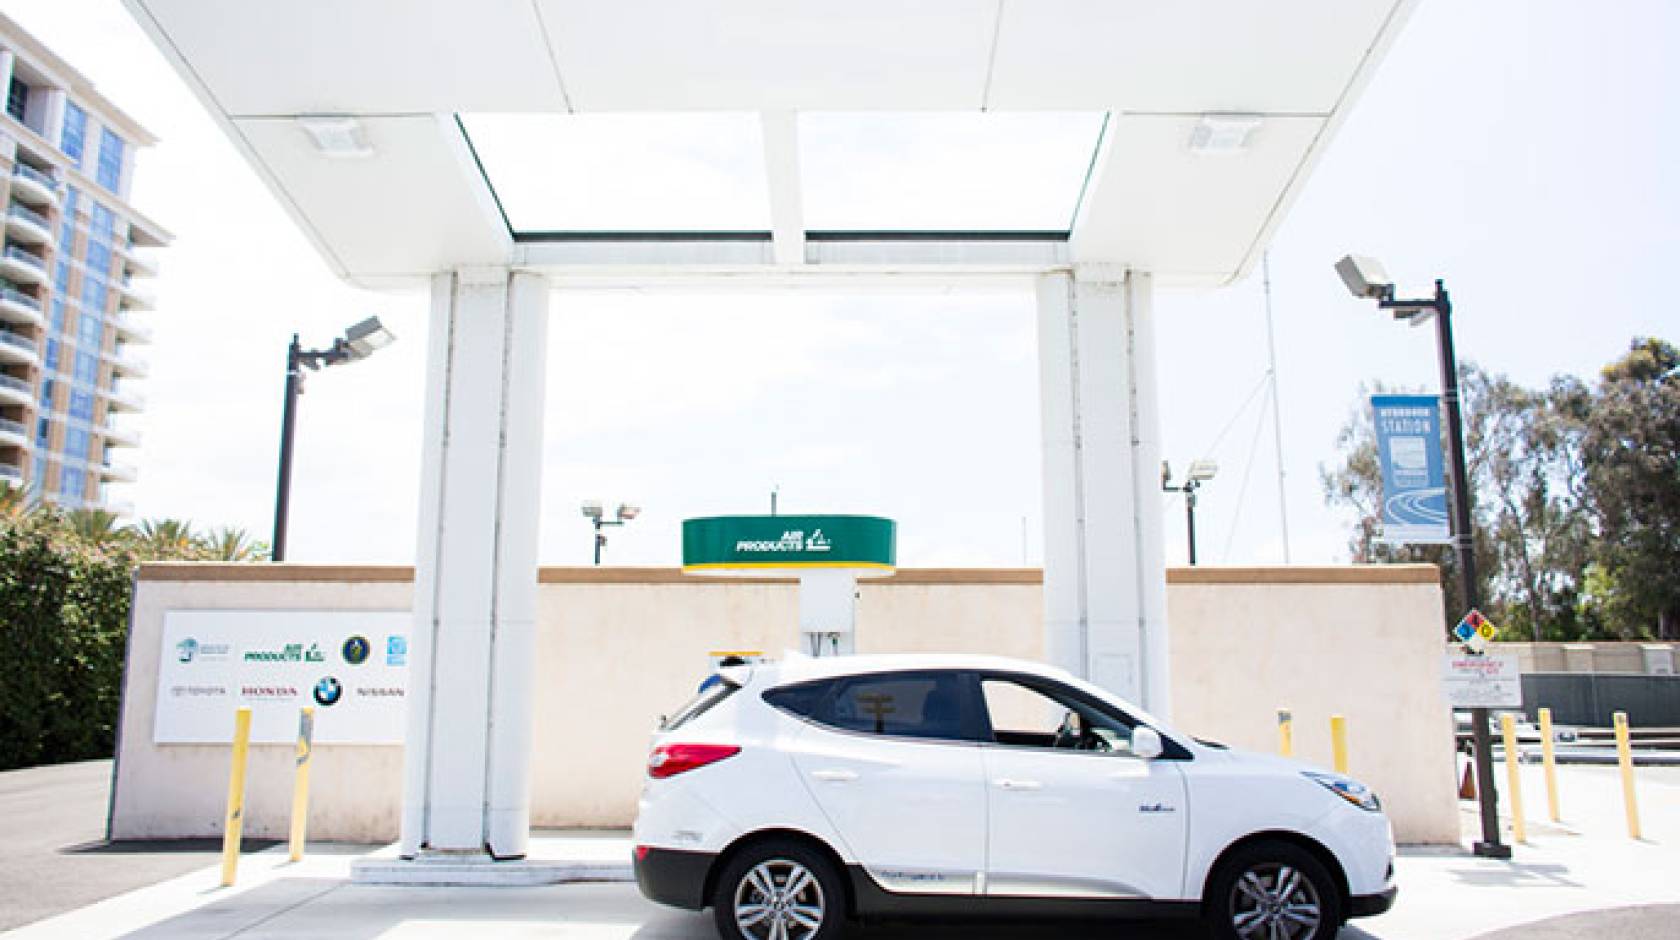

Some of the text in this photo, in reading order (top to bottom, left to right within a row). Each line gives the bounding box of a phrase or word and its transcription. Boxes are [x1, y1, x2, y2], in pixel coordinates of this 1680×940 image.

[1382, 419, 1431, 434] STATION
[781, 530, 804, 541] AIR
[736, 540, 804, 552] PRODUCTS
[244, 651, 302, 662] PRODUCTS
[241, 686, 297, 697] HONDA
[356, 687, 405, 697] NISSAN
